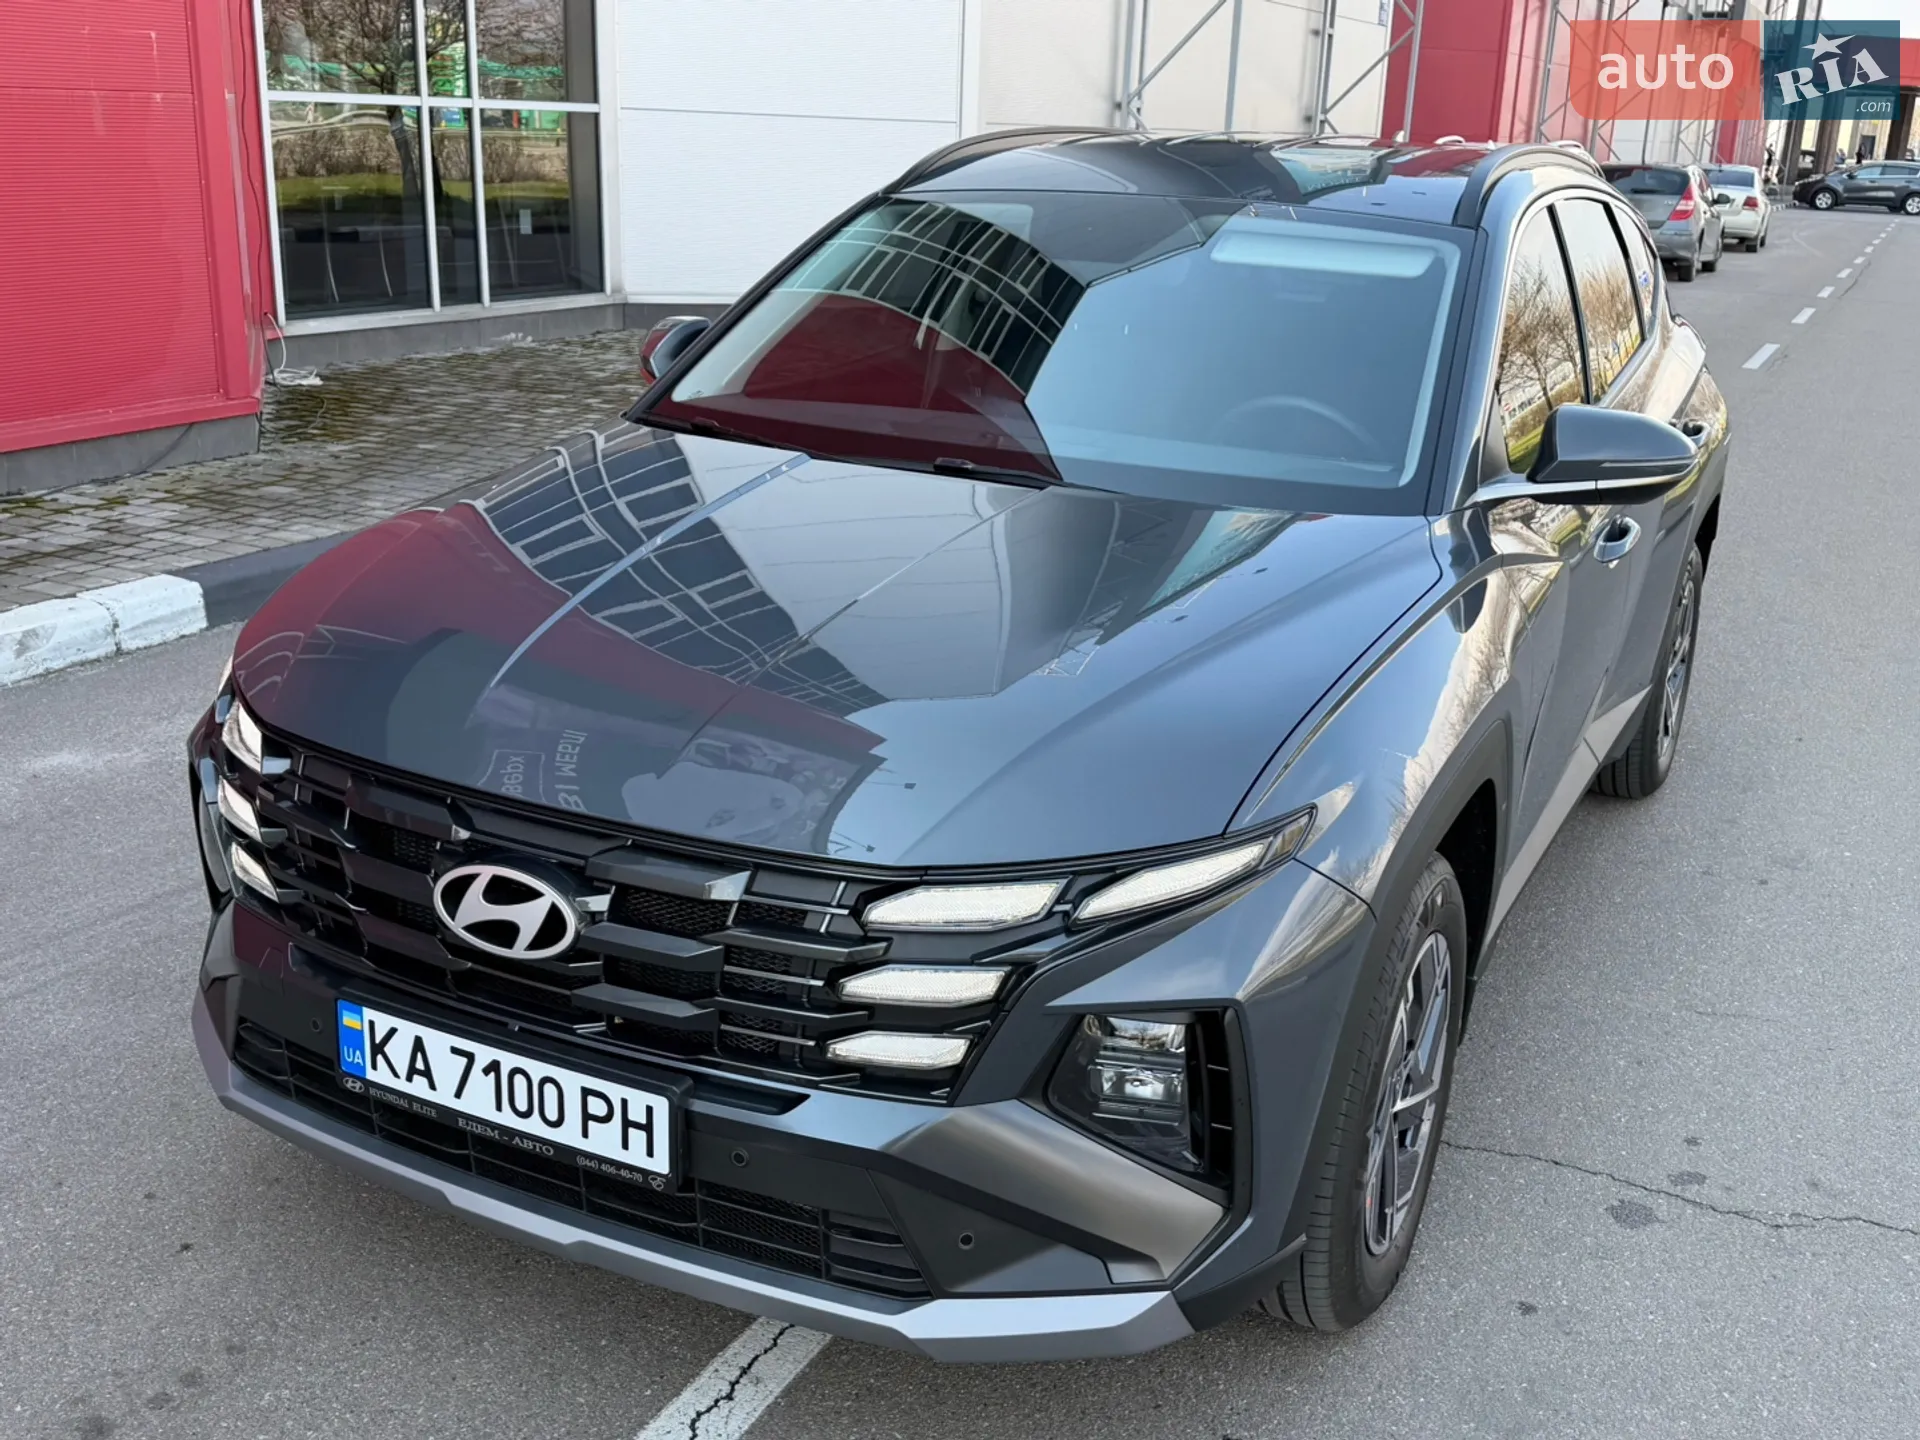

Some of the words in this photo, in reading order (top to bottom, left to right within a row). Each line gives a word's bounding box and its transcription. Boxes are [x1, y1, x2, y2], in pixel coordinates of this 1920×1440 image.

[344, 1046, 363, 1067] UA
[368, 1020, 437, 1091] KA
[450, 1046, 565, 1129] 7100
[581, 1086, 654, 1158] PH
[368, 1087, 409, 1107] HYUNDAI
[412, 1101, 437, 1118] ELITE
[512, 1136, 554, 1156] АВТО
